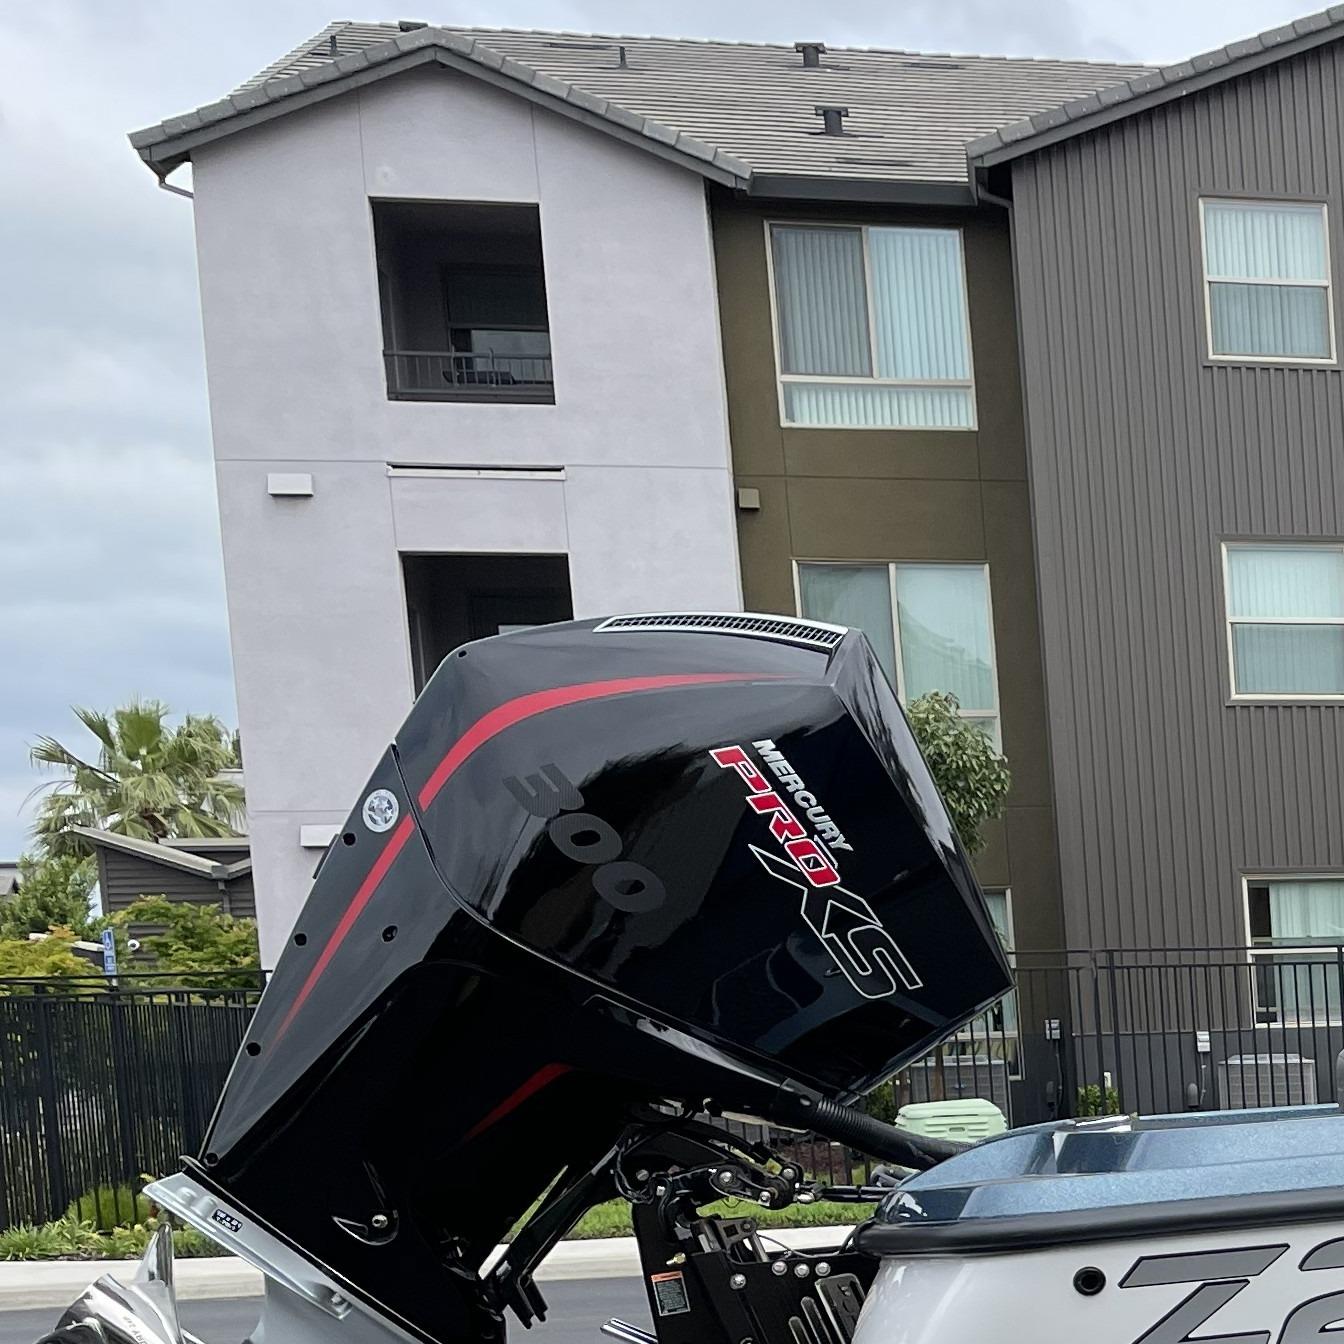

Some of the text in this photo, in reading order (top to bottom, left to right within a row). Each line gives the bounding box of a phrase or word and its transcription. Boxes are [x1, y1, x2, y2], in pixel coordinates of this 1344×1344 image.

[502, 763, 667, 913] 300
[752, 739, 853, 851] MERCURY
[709, 745, 923, 999] PRO XS
